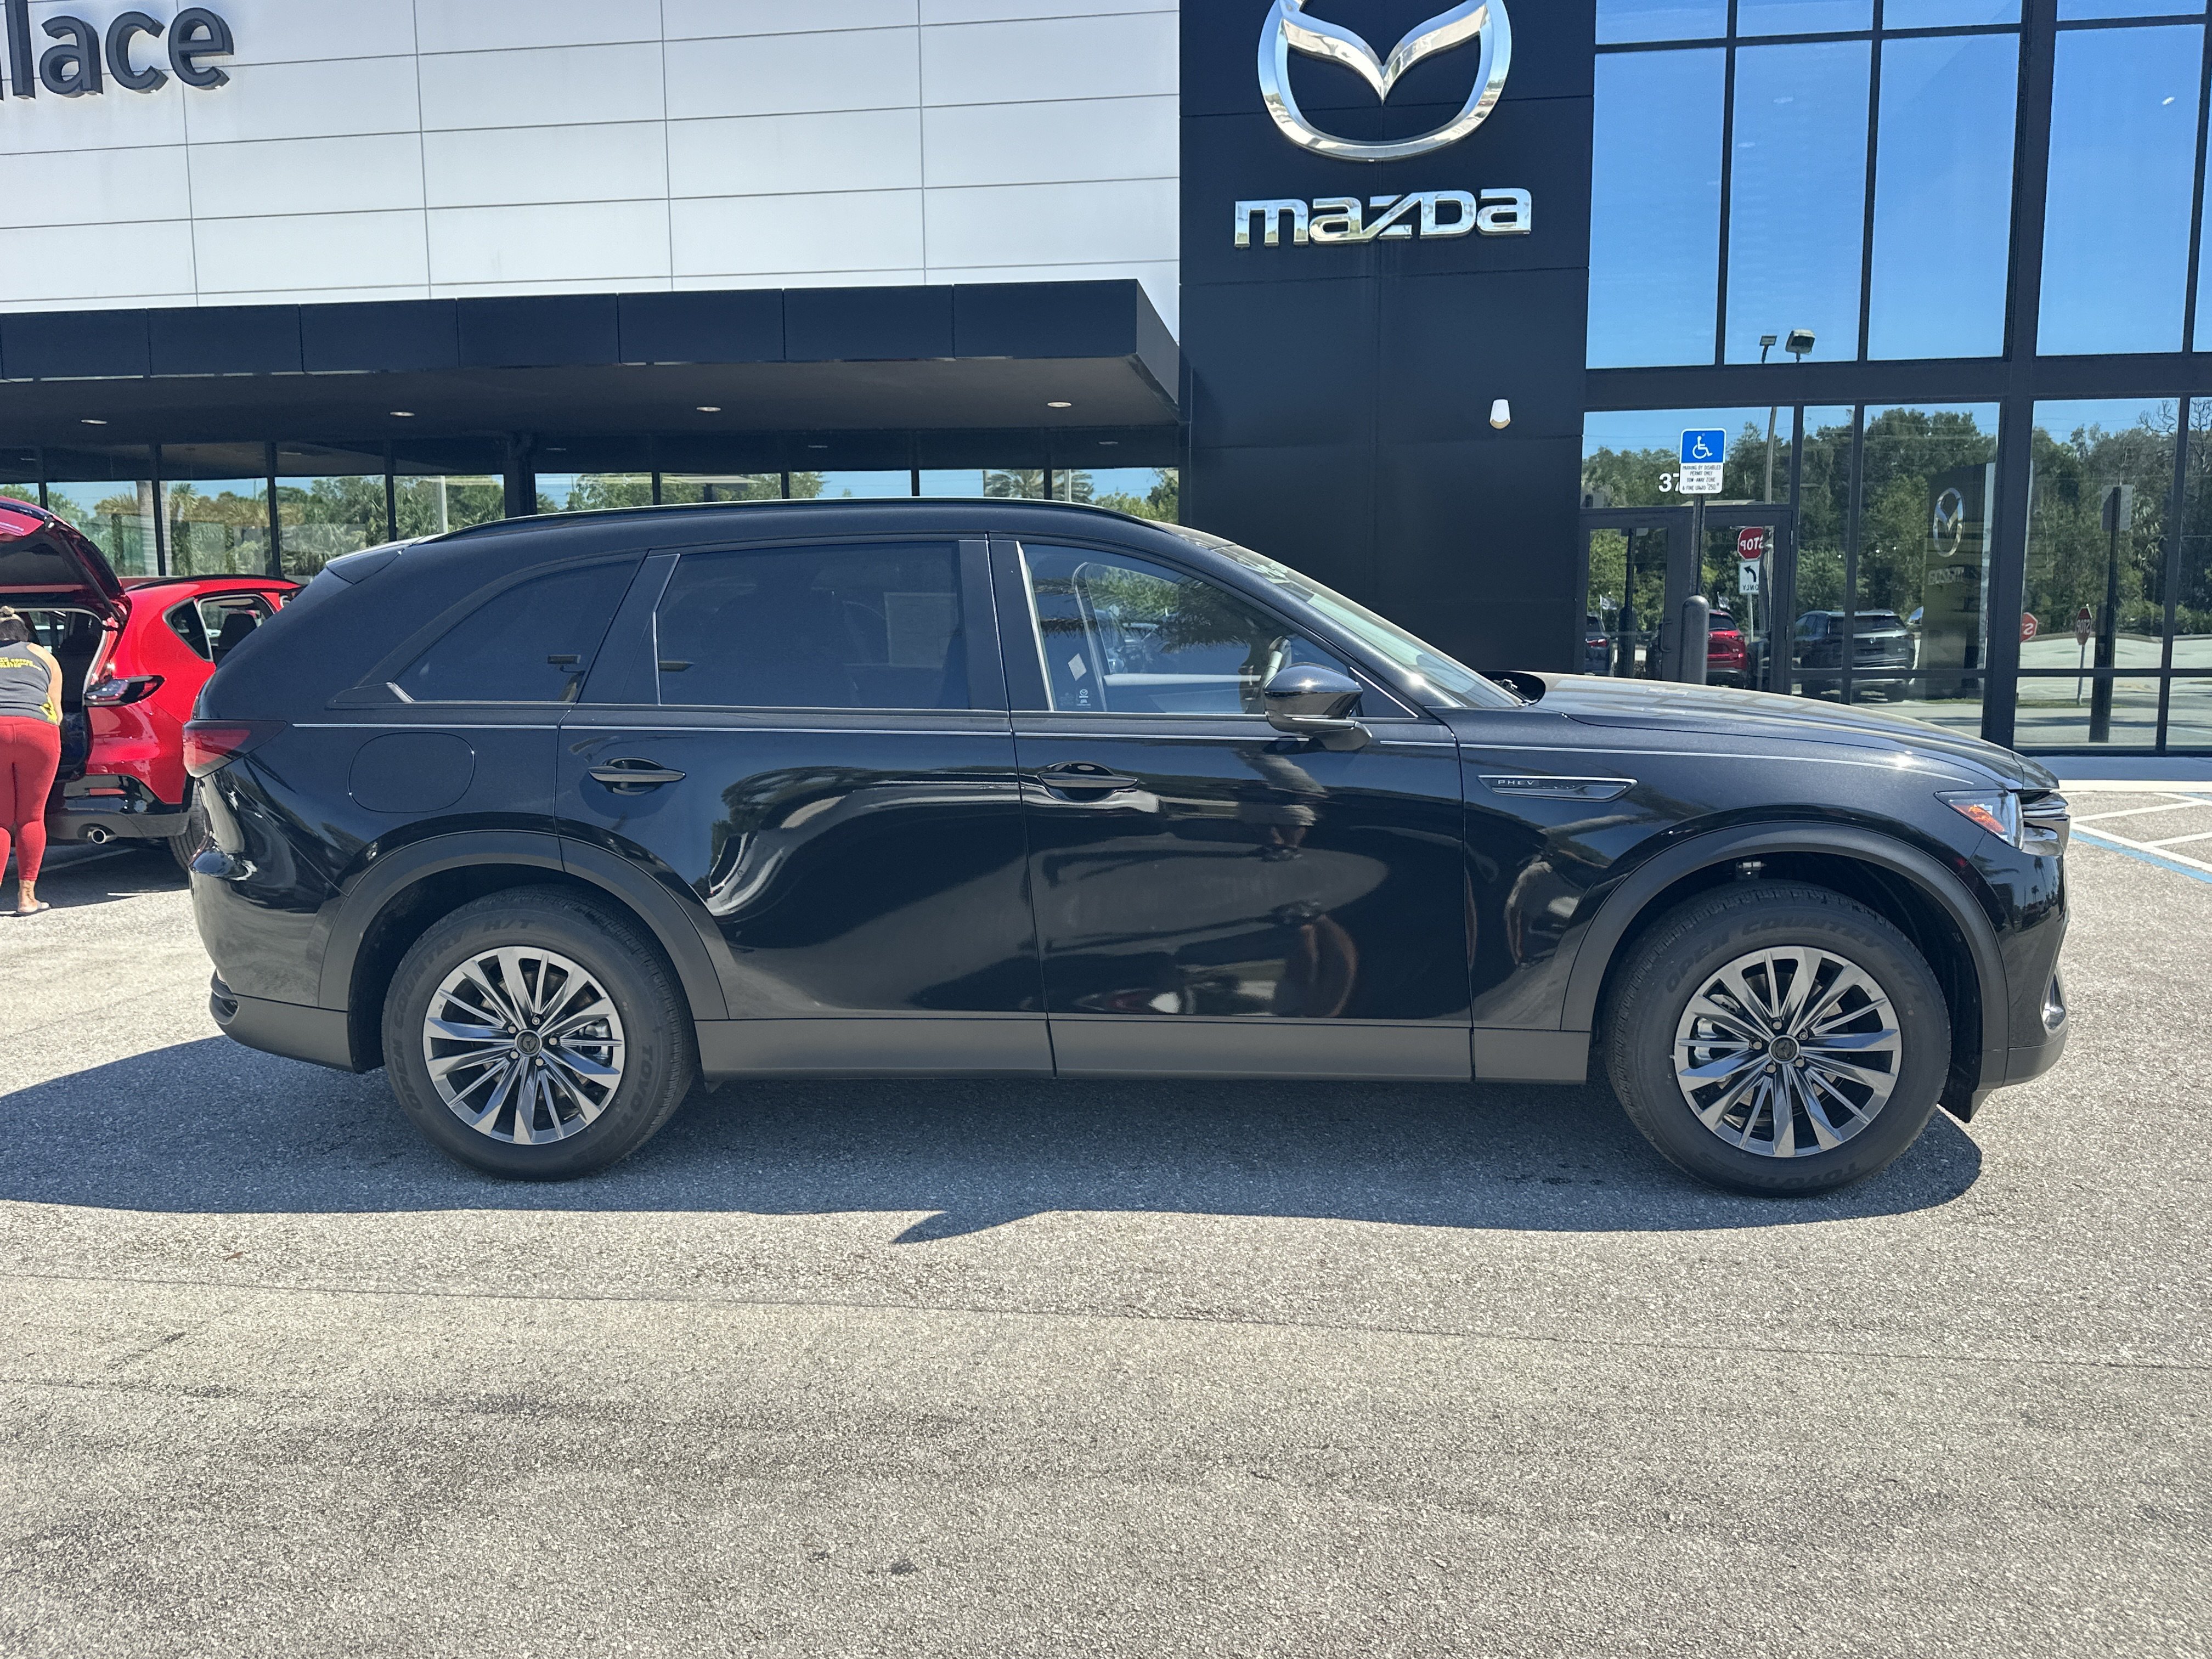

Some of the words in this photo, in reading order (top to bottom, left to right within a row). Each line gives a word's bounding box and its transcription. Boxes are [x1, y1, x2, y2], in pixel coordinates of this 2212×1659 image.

[0, 0, 234, 100] lace
[483, 918, 535, 933] H/T
[1742, 917, 1881, 947] COUNTRY
[394, 933, 465, 1029] COUNTRY
[392, 1038, 422, 1110] OPEN
[630, 1045, 654, 1111] TOYO
